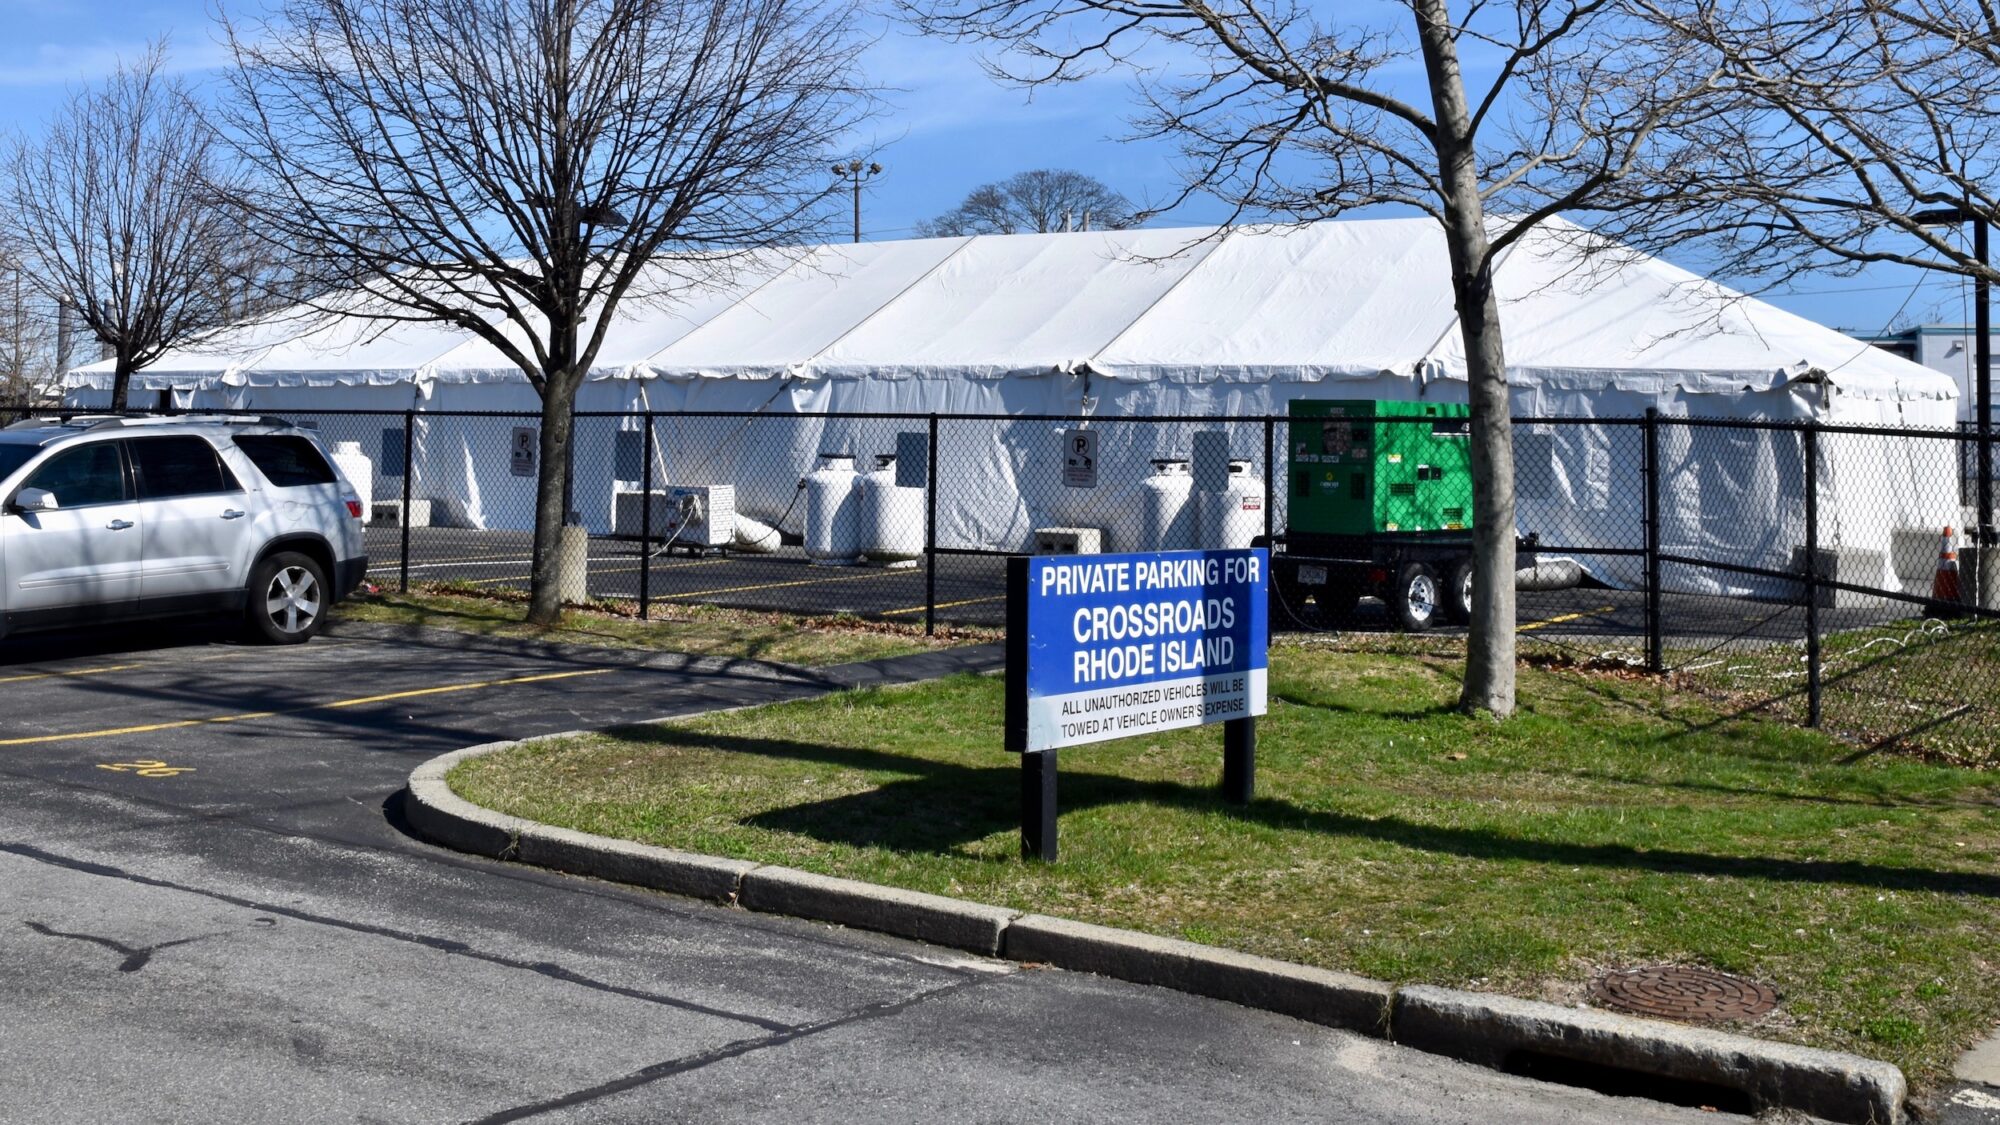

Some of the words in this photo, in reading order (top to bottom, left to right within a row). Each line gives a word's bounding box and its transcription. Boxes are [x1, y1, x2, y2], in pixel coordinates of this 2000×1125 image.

[1042, 563, 1129, 596] PRIVATE
[1136, 558, 1218, 590] PARKING
[1225, 556, 1259, 583] FOR
[1073, 597, 1235, 643] CROSSROADS
[1074, 643, 1154, 683] RHODE
[1161, 636, 1234, 673] ISLAND
[1062, 701, 1081, 716] ALL
[1084, 689, 1160, 713] UNAUTHORIZED
[1163, 682, 1207, 701] VEHICLES
[1210, 680, 1230, 695] WILL
[1233, 678, 1244, 692] BE
[1061, 720, 1099, 738] TOWED
[1102, 717, 1114, 732] AT
[1117, 710, 1157, 729] VEHICLE
[1160, 704, 1203, 723] OWNER'S
[1205, 698, 1244, 716] EXPENSE
